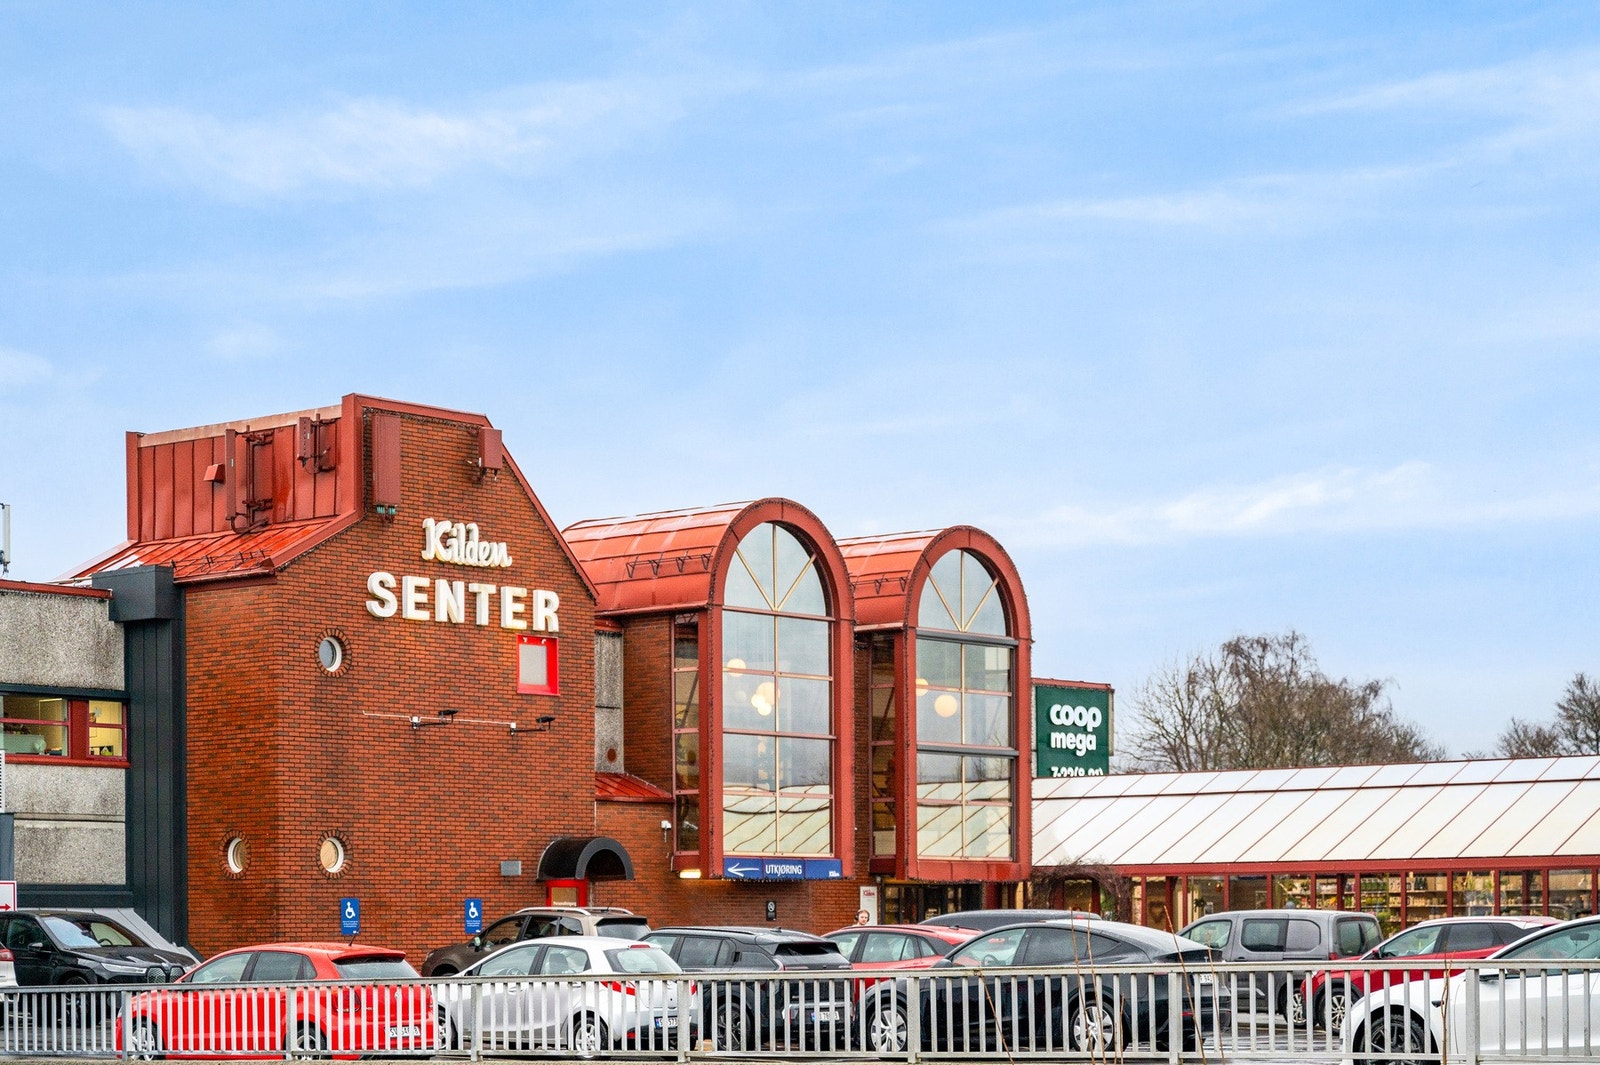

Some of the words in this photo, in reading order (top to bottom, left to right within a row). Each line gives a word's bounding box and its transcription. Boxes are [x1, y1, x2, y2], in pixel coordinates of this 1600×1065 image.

[422, 517, 513, 567] Kilden
[366, 572, 560, 632] SENTER
[1050, 704, 1102, 732] coop
[1050, 732, 1097, 756] mega
[765, 864, 802, 876] UTKJØRING
